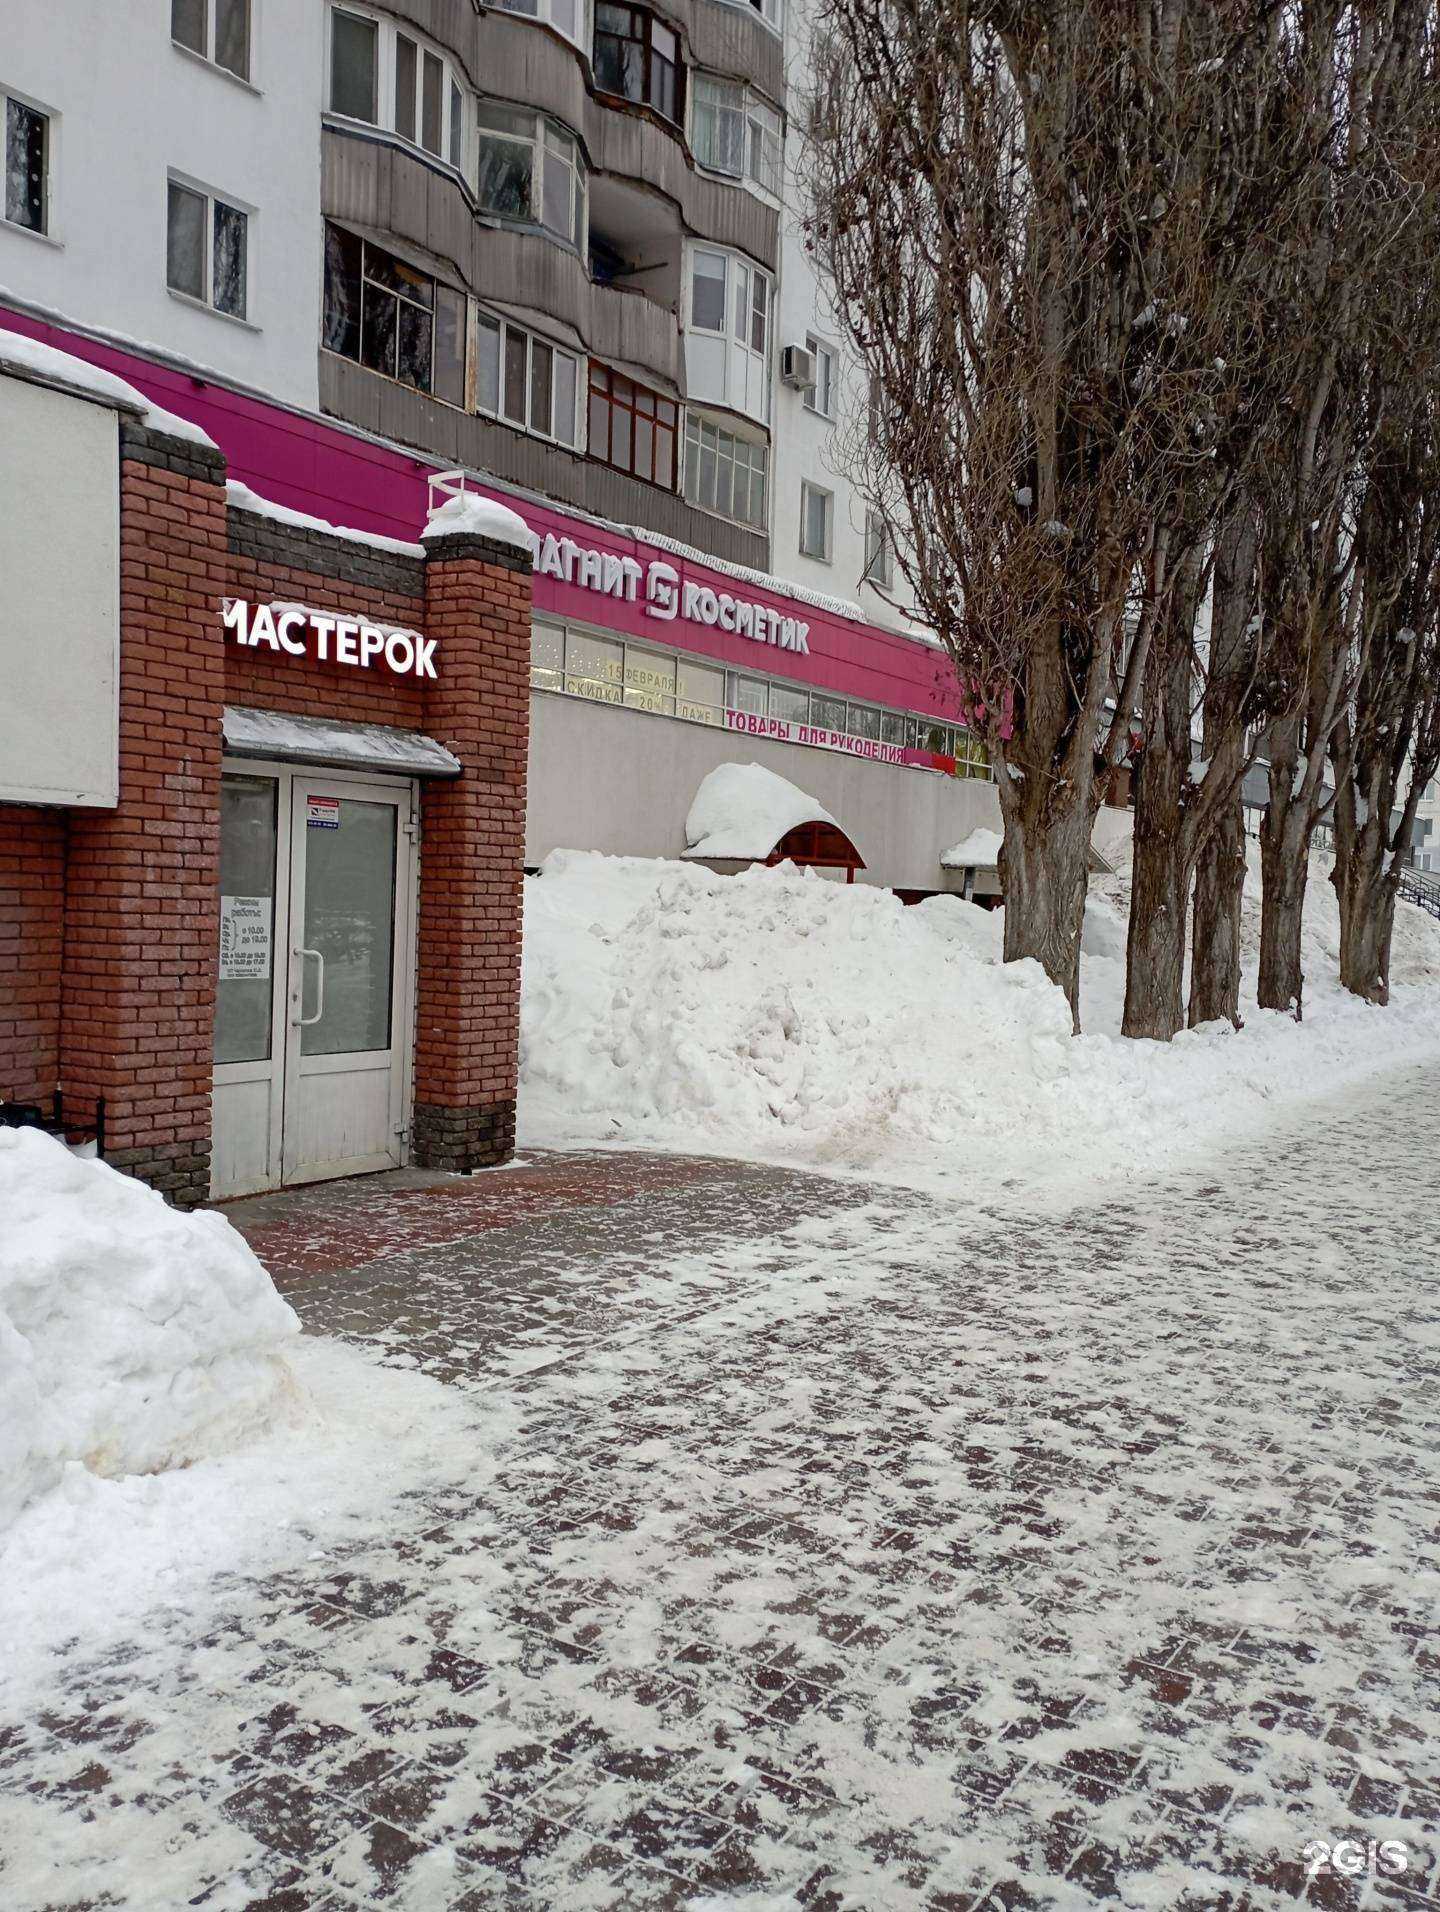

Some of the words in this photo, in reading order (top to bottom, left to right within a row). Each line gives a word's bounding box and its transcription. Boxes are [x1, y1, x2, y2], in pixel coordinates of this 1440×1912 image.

[682, 580, 810, 656] КОСМЕТИК
[607, 663, 622, 681] 15
[567, 680, 621, 704] СКИДКА
[726, 710, 790, 739] ТОВАРЫ
[798, 726, 827, 745] ДЛЯ
[830, 733, 905, 764] РУКОДЕЛИЯ
